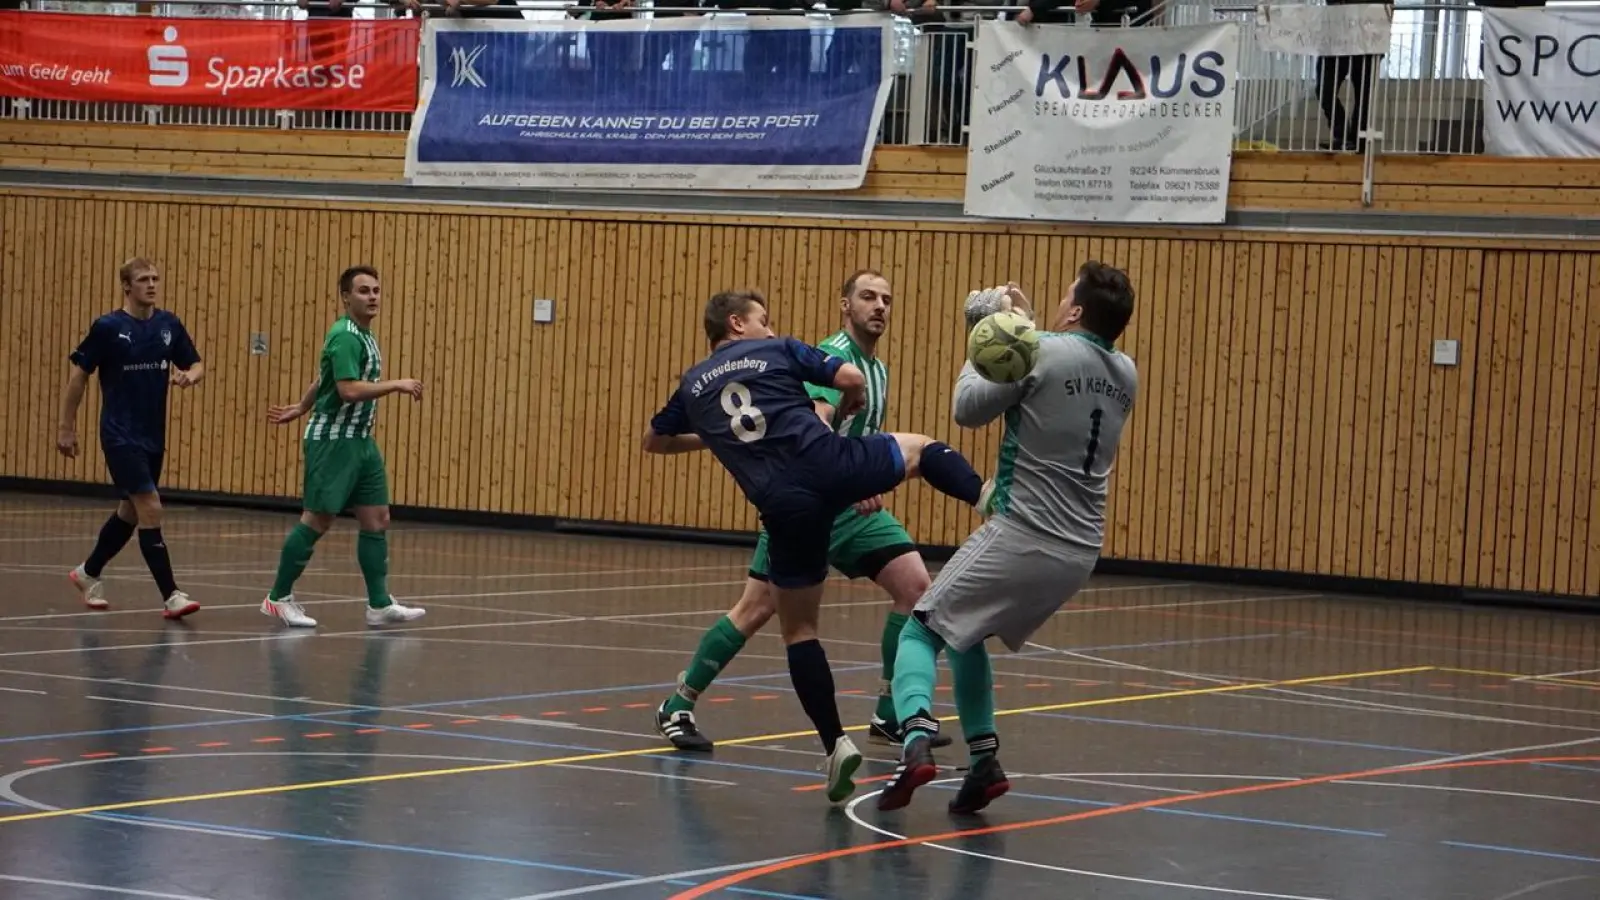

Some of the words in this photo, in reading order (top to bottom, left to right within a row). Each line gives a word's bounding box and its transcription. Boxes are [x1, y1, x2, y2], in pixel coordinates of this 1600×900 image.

[1496, 34, 1600, 77] SPO
[29, 63, 70, 81] Geld
[71, 66, 112, 85] geht
[205, 57, 365, 95] Sparkasse
[1035, 47, 1226, 100] KLAUS
[988, 88, 1026, 115] Flachdach
[478, 114, 576, 127] AUFGEBEN
[579, 116, 656, 129] KANNST
[658, 116, 686, 129] DU
[688, 116, 719, 129] BEI
[721, 116, 761, 129] DER
[763, 114, 820, 127] POST!
[735, 131, 767, 139] SPORT
[981, 170, 1015, 192] Balkone
[1100, 165, 1112, 176] 27
[1034, 178, 1061, 188] Telefon
[1130, 180, 1161, 190] Telefax
[1164, 180, 1192, 191] 09621
[691, 380, 704, 397] SV
[701, 357, 768, 384] Freudenberg
[1064, 379, 1082, 396] SV
[720, 382, 767, 443] 8
[1083, 409, 1105, 477] 1
